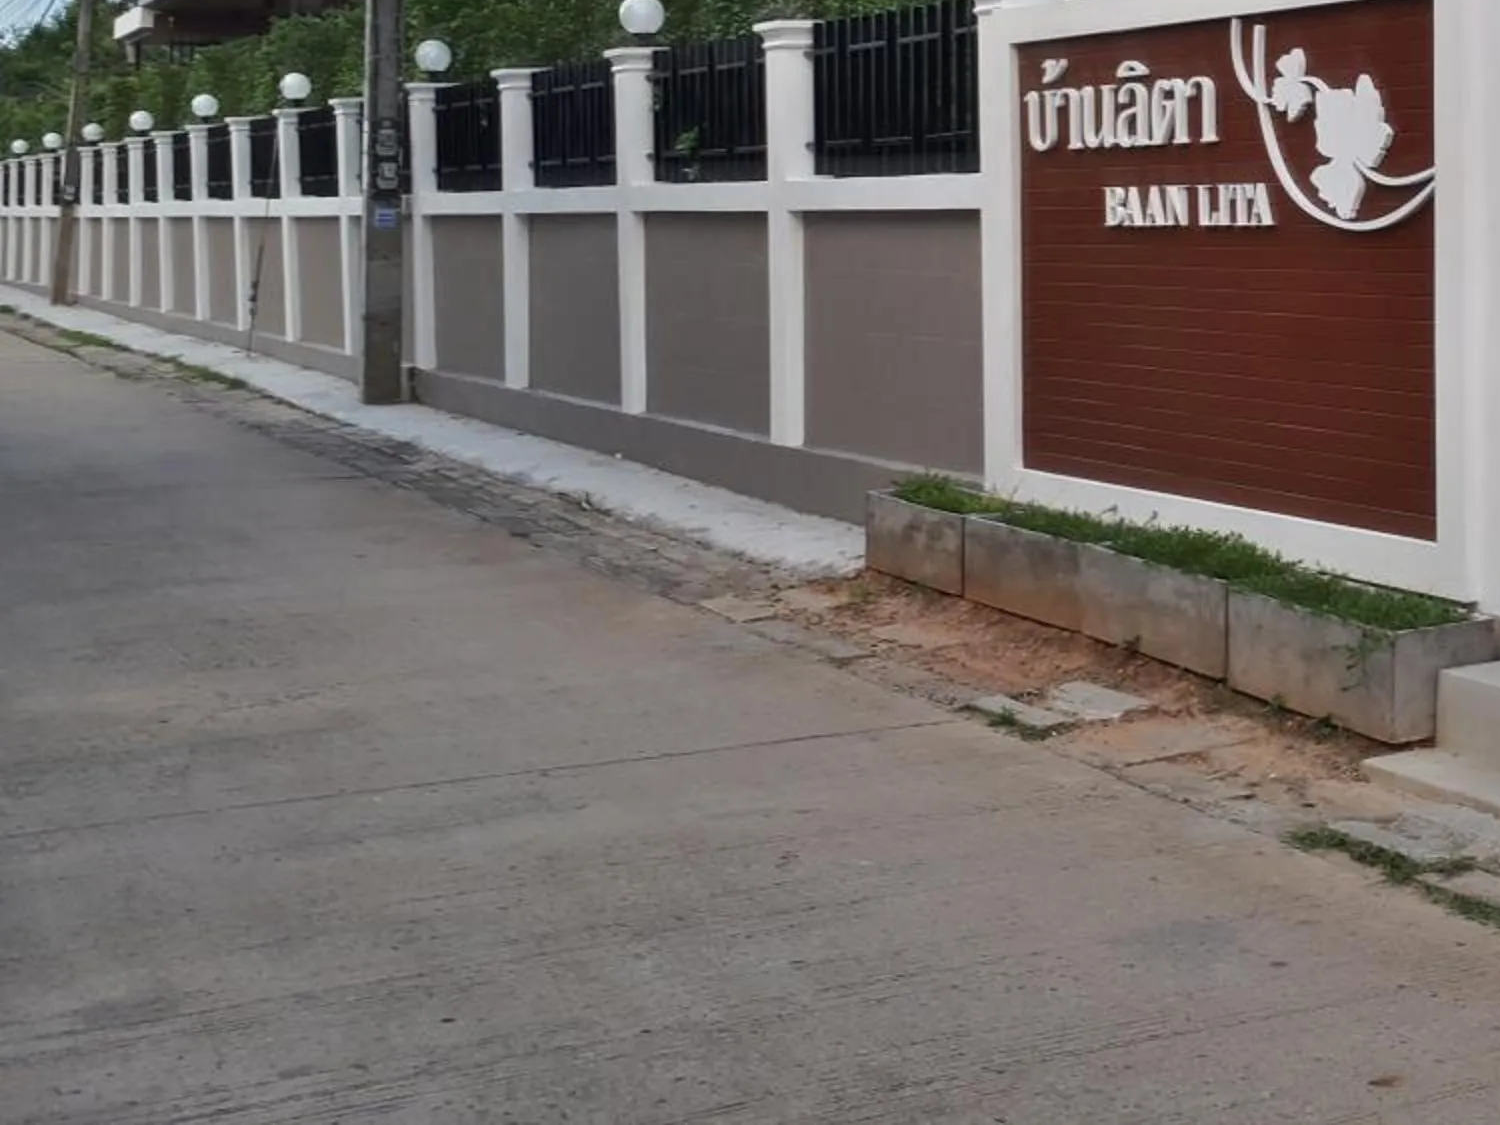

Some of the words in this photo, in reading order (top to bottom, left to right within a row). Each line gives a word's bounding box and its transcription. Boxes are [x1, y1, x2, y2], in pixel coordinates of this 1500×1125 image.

[1024, 58, 1220, 152] บ้านลิตา
[1103, 184, 1189, 227] BAAN
[1196, 182, 1275, 226] LITA
